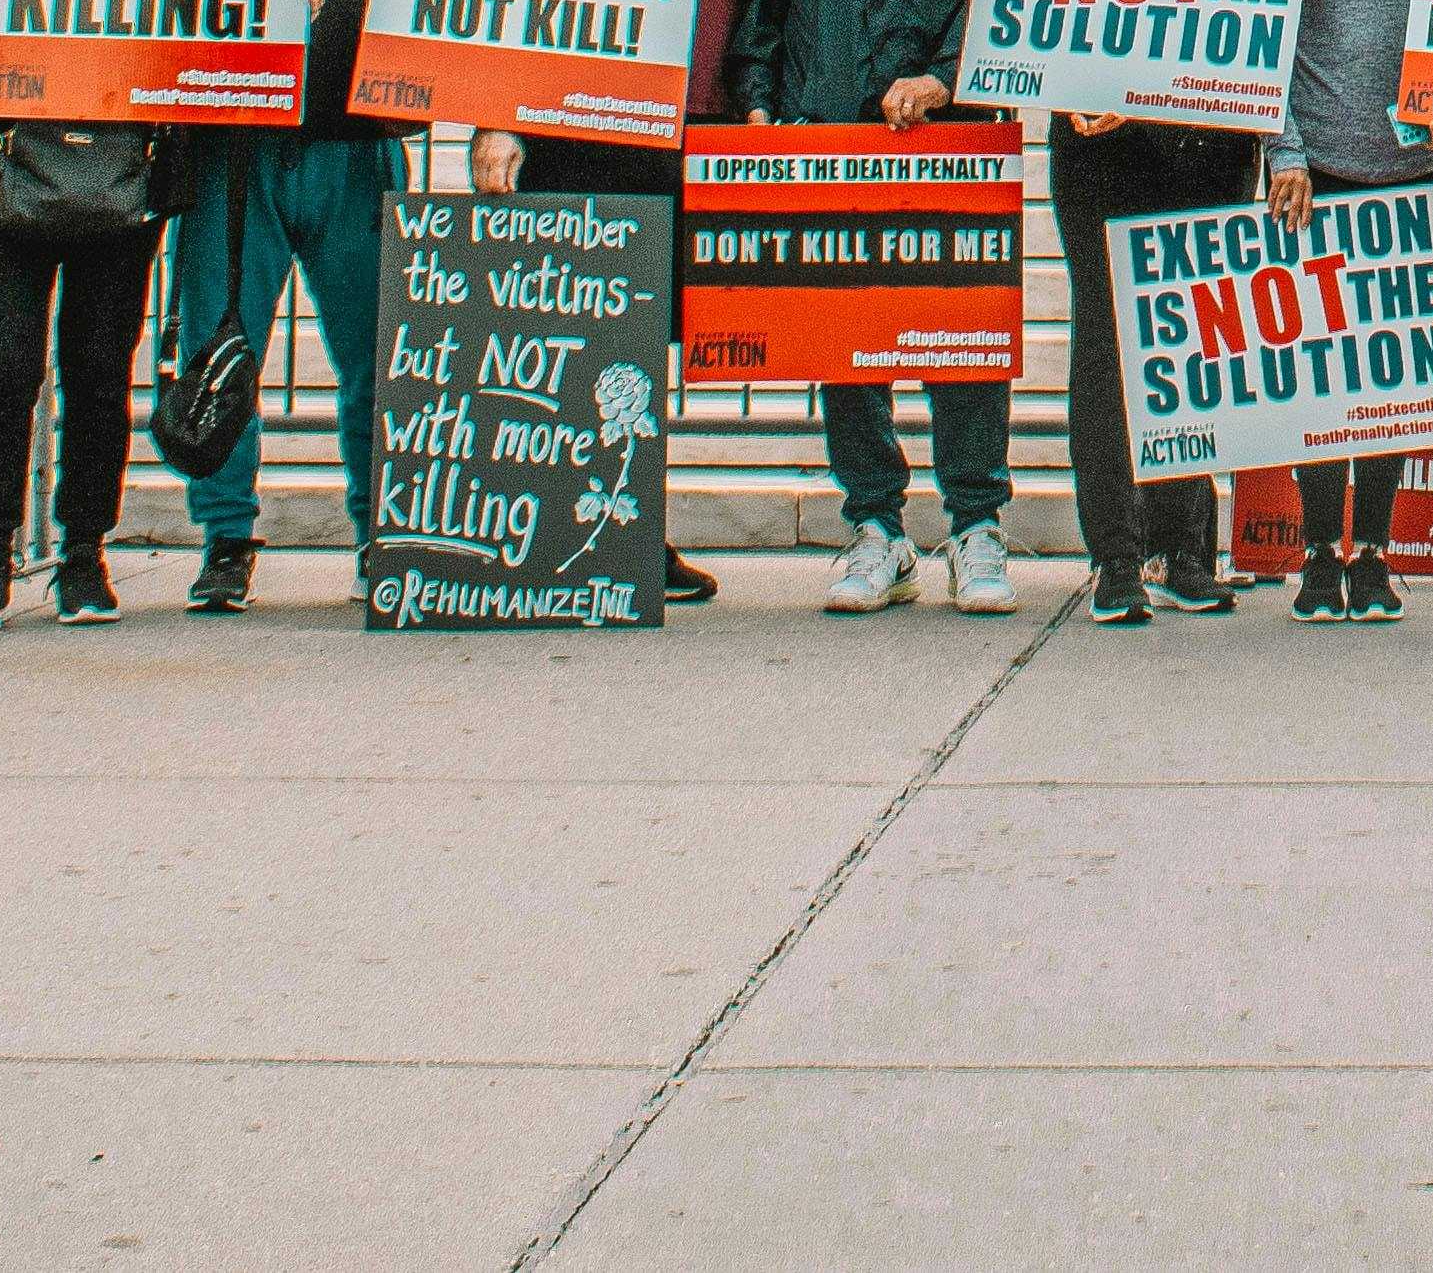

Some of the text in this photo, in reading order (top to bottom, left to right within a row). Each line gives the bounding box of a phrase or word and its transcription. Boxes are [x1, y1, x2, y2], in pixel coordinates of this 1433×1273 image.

[968, 66, 1043, 96] ACTION
[1125, 91, 1279, 119] DeathPenaltyAction.org
[1171, 76, 1282, 98] #StopExecutions
[701, 157, 1005, 181] I OPPOSE THE DEATH PENALTY
[470, 198, 639, 250] remember
[694, 228, 1013, 264] DON'T KILL FOR ME!
[1129, 193, 1433, 285] EXECUTION
[403, 249, 469, 305] the
[1136, 291, 1188, 349] IS
[1191, 254, 1348, 359] NOT
[387, 322, 586, 395] but NOT
[382, 392, 596, 467] with more
[1140, 432, 1217, 468] ACTION
[377, 460, 540, 567] killing
[373, 567, 640, 628] @REHUMANIZEINTL
